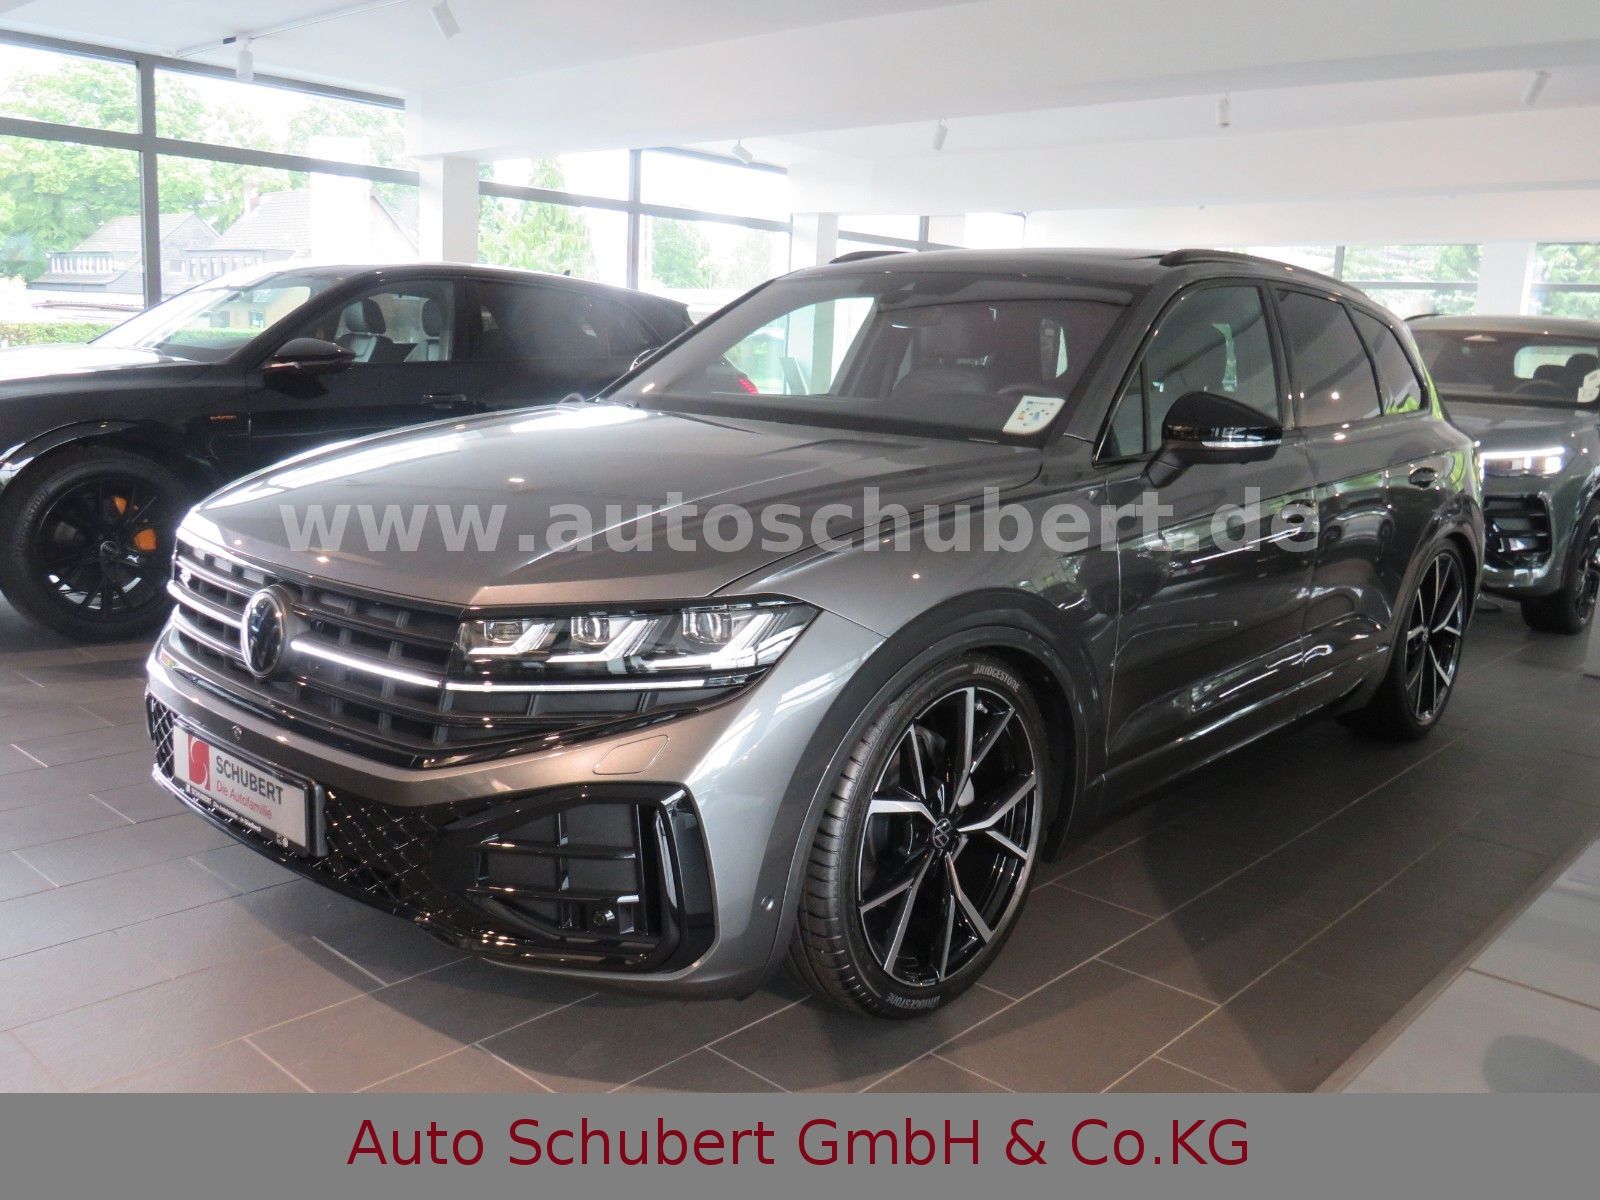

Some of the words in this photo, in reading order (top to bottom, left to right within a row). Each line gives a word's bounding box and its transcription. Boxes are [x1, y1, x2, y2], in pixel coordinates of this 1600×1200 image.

[973, 663, 1021, 693] BRIDGESTONE
[215, 755, 284, 805] SCHUBERT
[216, 780, 229, 797] Die
[229, 788, 273, 821] Autofamilie
